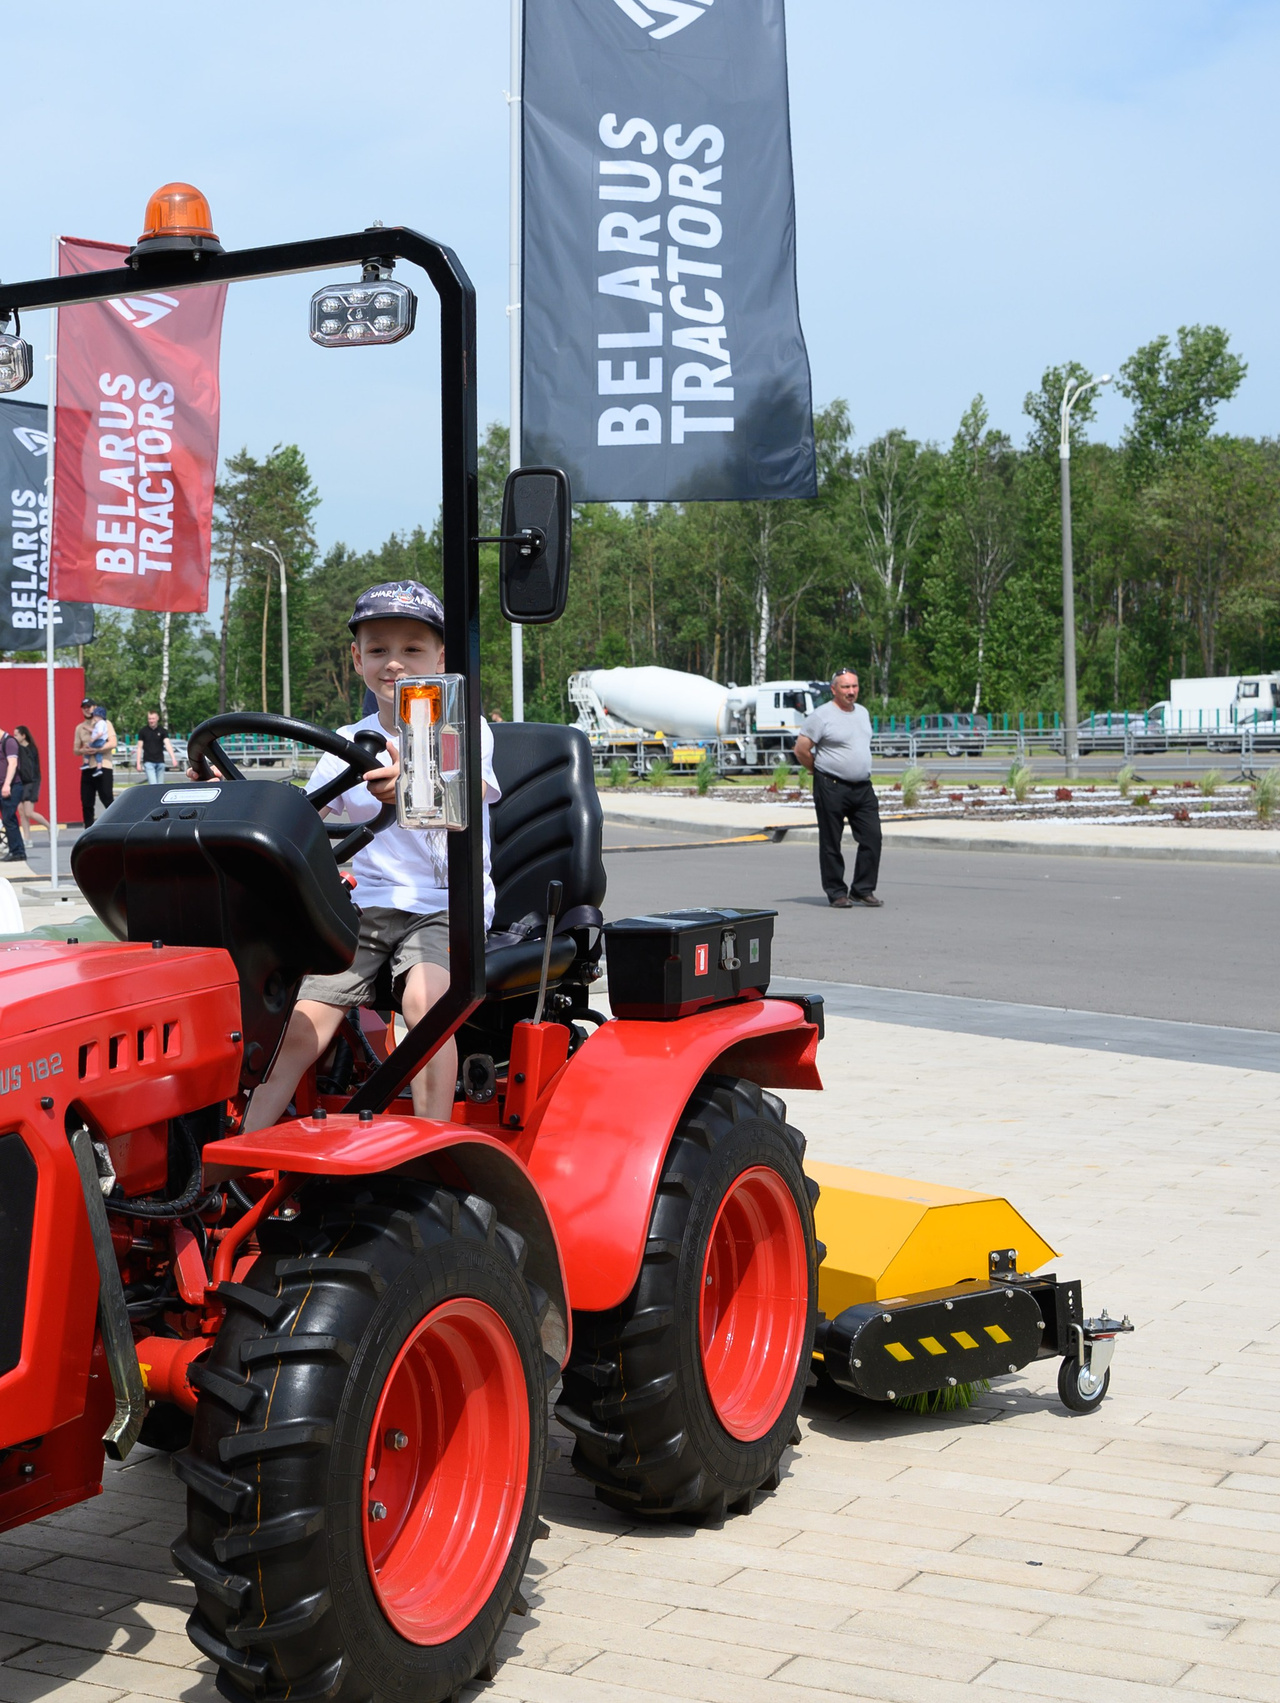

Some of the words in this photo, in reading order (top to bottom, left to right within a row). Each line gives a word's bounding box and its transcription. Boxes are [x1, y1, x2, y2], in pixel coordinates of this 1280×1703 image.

[597, 112, 663, 447] BELARUS
[662, 122, 735, 445] TRACTORS
[11, 489, 39, 630] BELARUS
[95, 372, 136, 575] BELARUS
[136, 378, 175, 576] TRACTORS
[27, 1051, 64, 1083] 182
